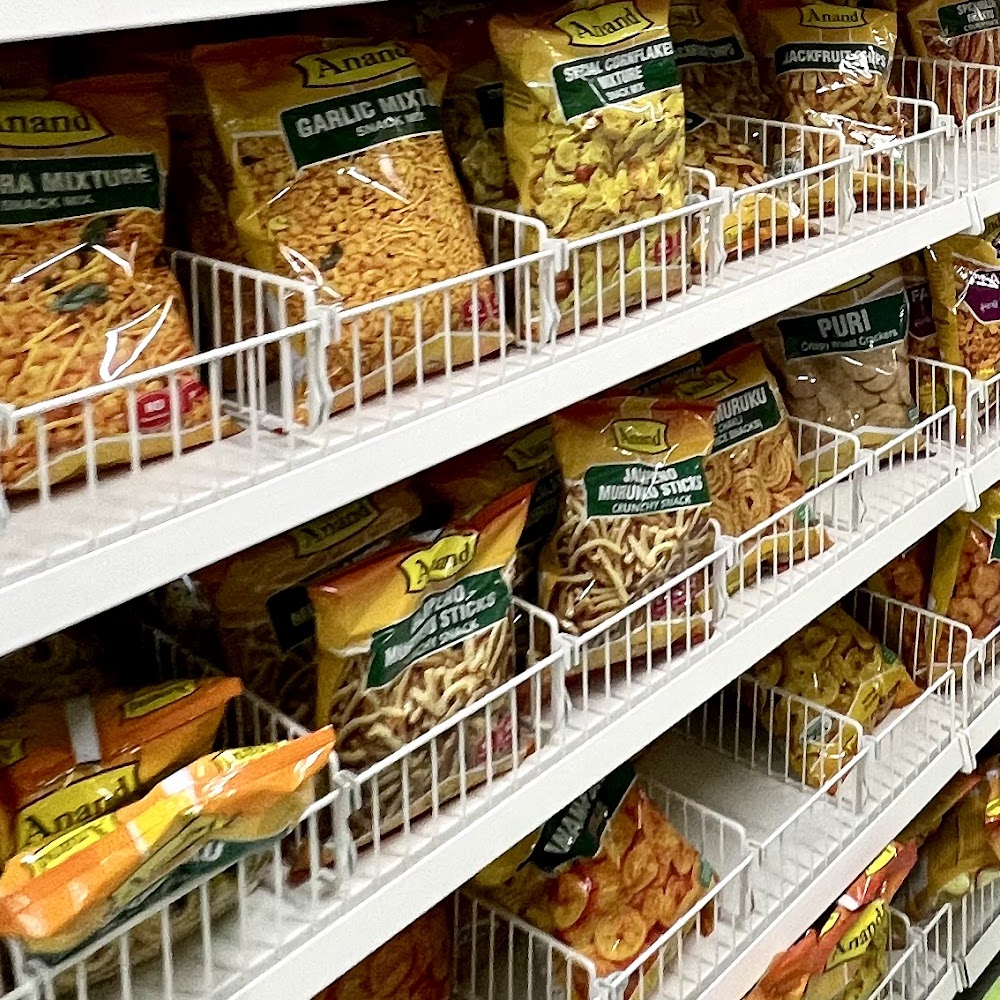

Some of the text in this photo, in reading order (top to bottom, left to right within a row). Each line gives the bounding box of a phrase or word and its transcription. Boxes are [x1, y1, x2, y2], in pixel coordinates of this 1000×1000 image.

[568, 6, 643, 39] Anand
[807, 9, 859, 24] Anand
[782, 48, 849, 66] JACKFRUIT
[0, 113, 91, 133] nand
[295, 101, 376, 139] GARLIC
[355, 115, 405, 138] SNACK
[41, 164, 154, 192] MIXTURE
[816, 307, 873, 339] PURI
[858, 328, 899, 348] Crackers
[659, 474, 704, 496] STICKS
[439, 591, 497, 627] STICKS
[22, 774, 133, 841] Anand
[837, 905, 885, 954] Anand
